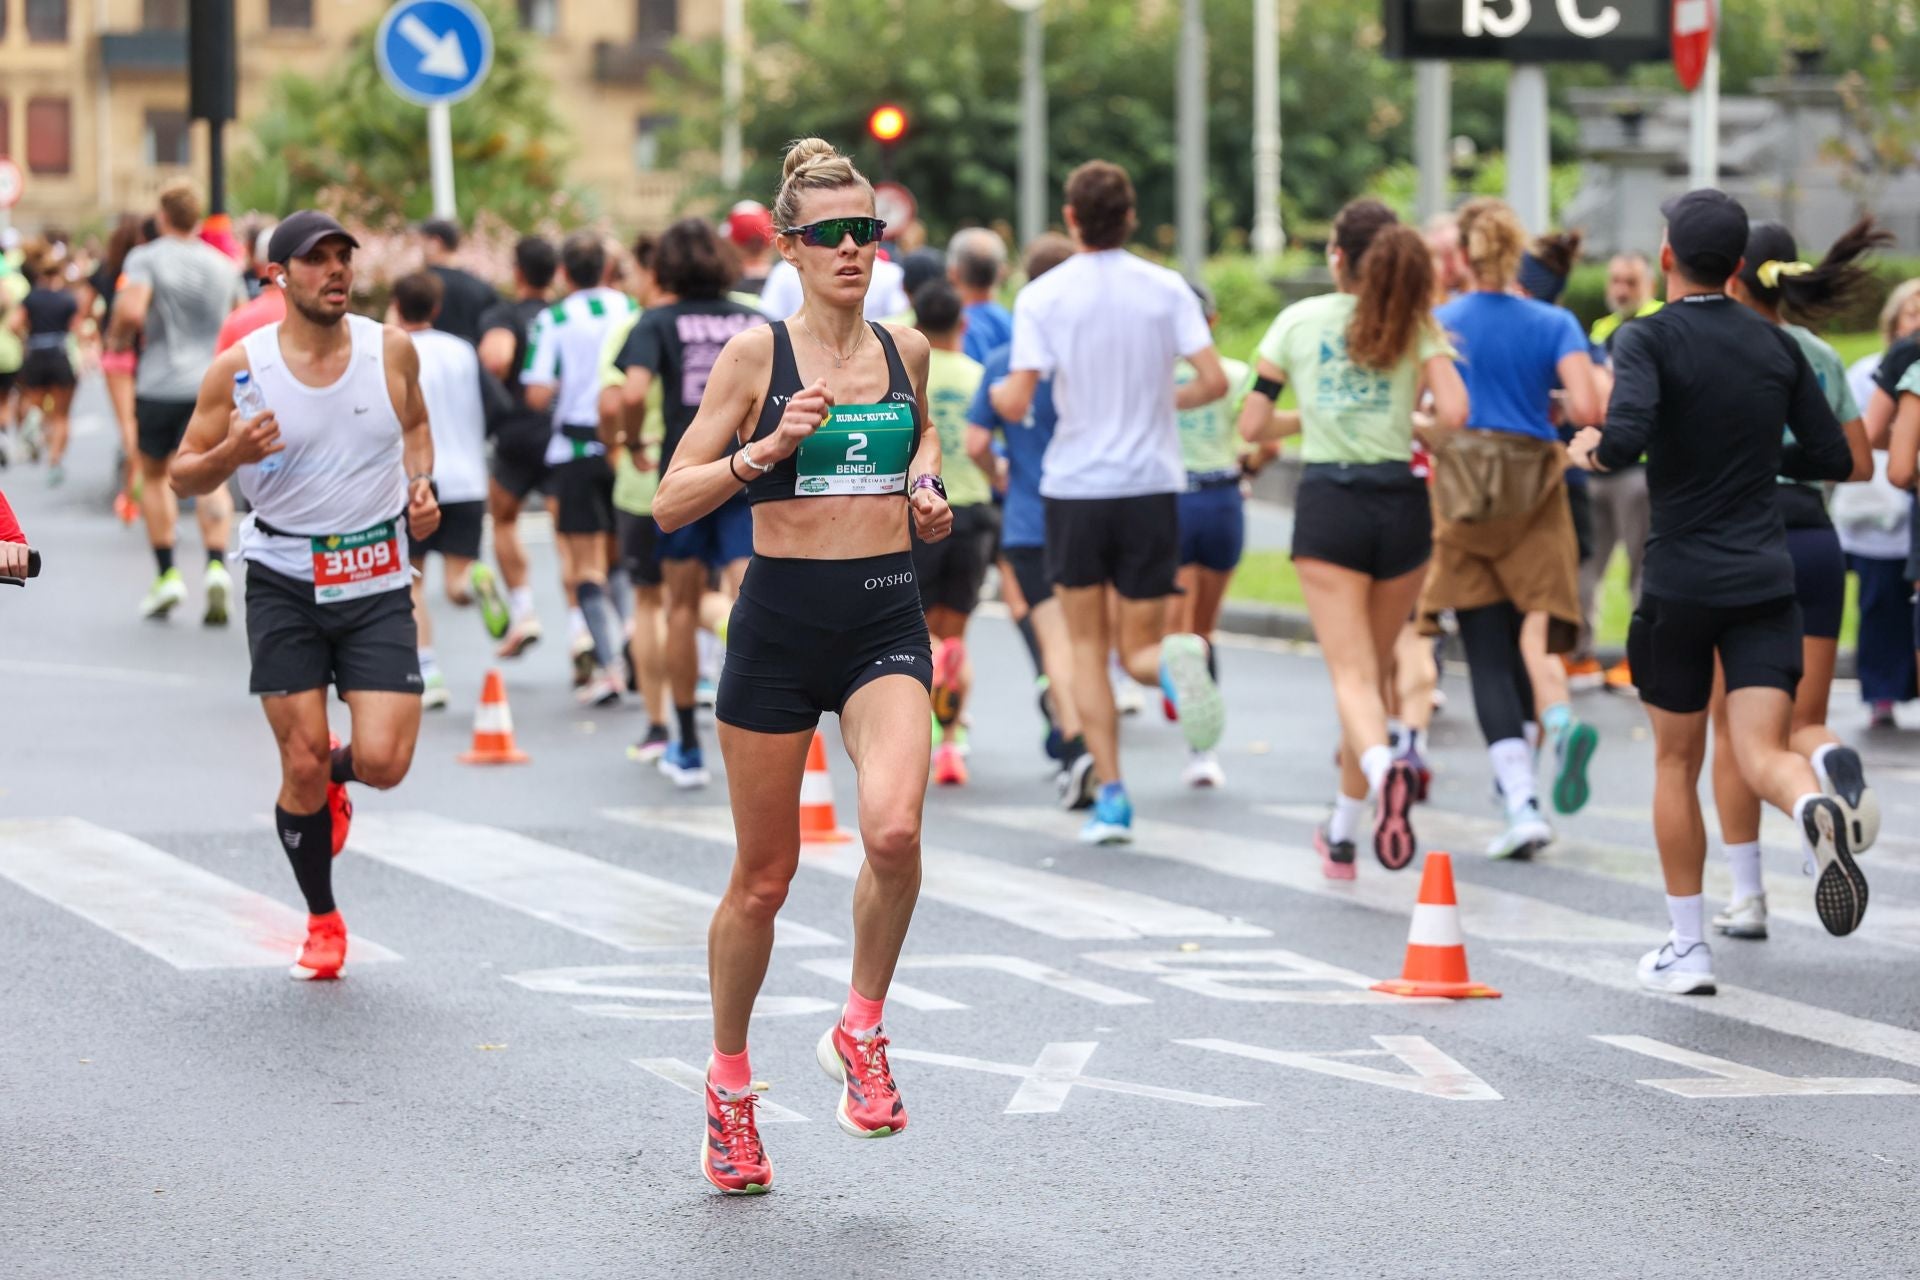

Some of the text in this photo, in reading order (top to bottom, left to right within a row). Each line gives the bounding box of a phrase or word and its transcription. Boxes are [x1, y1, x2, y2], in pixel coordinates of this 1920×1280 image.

[845, 432, 868, 462] 2
[836, 461, 877, 474] BENEDÍ
[323, 541, 391, 576] 3109
[864, 571, 913, 590] OYSHO
